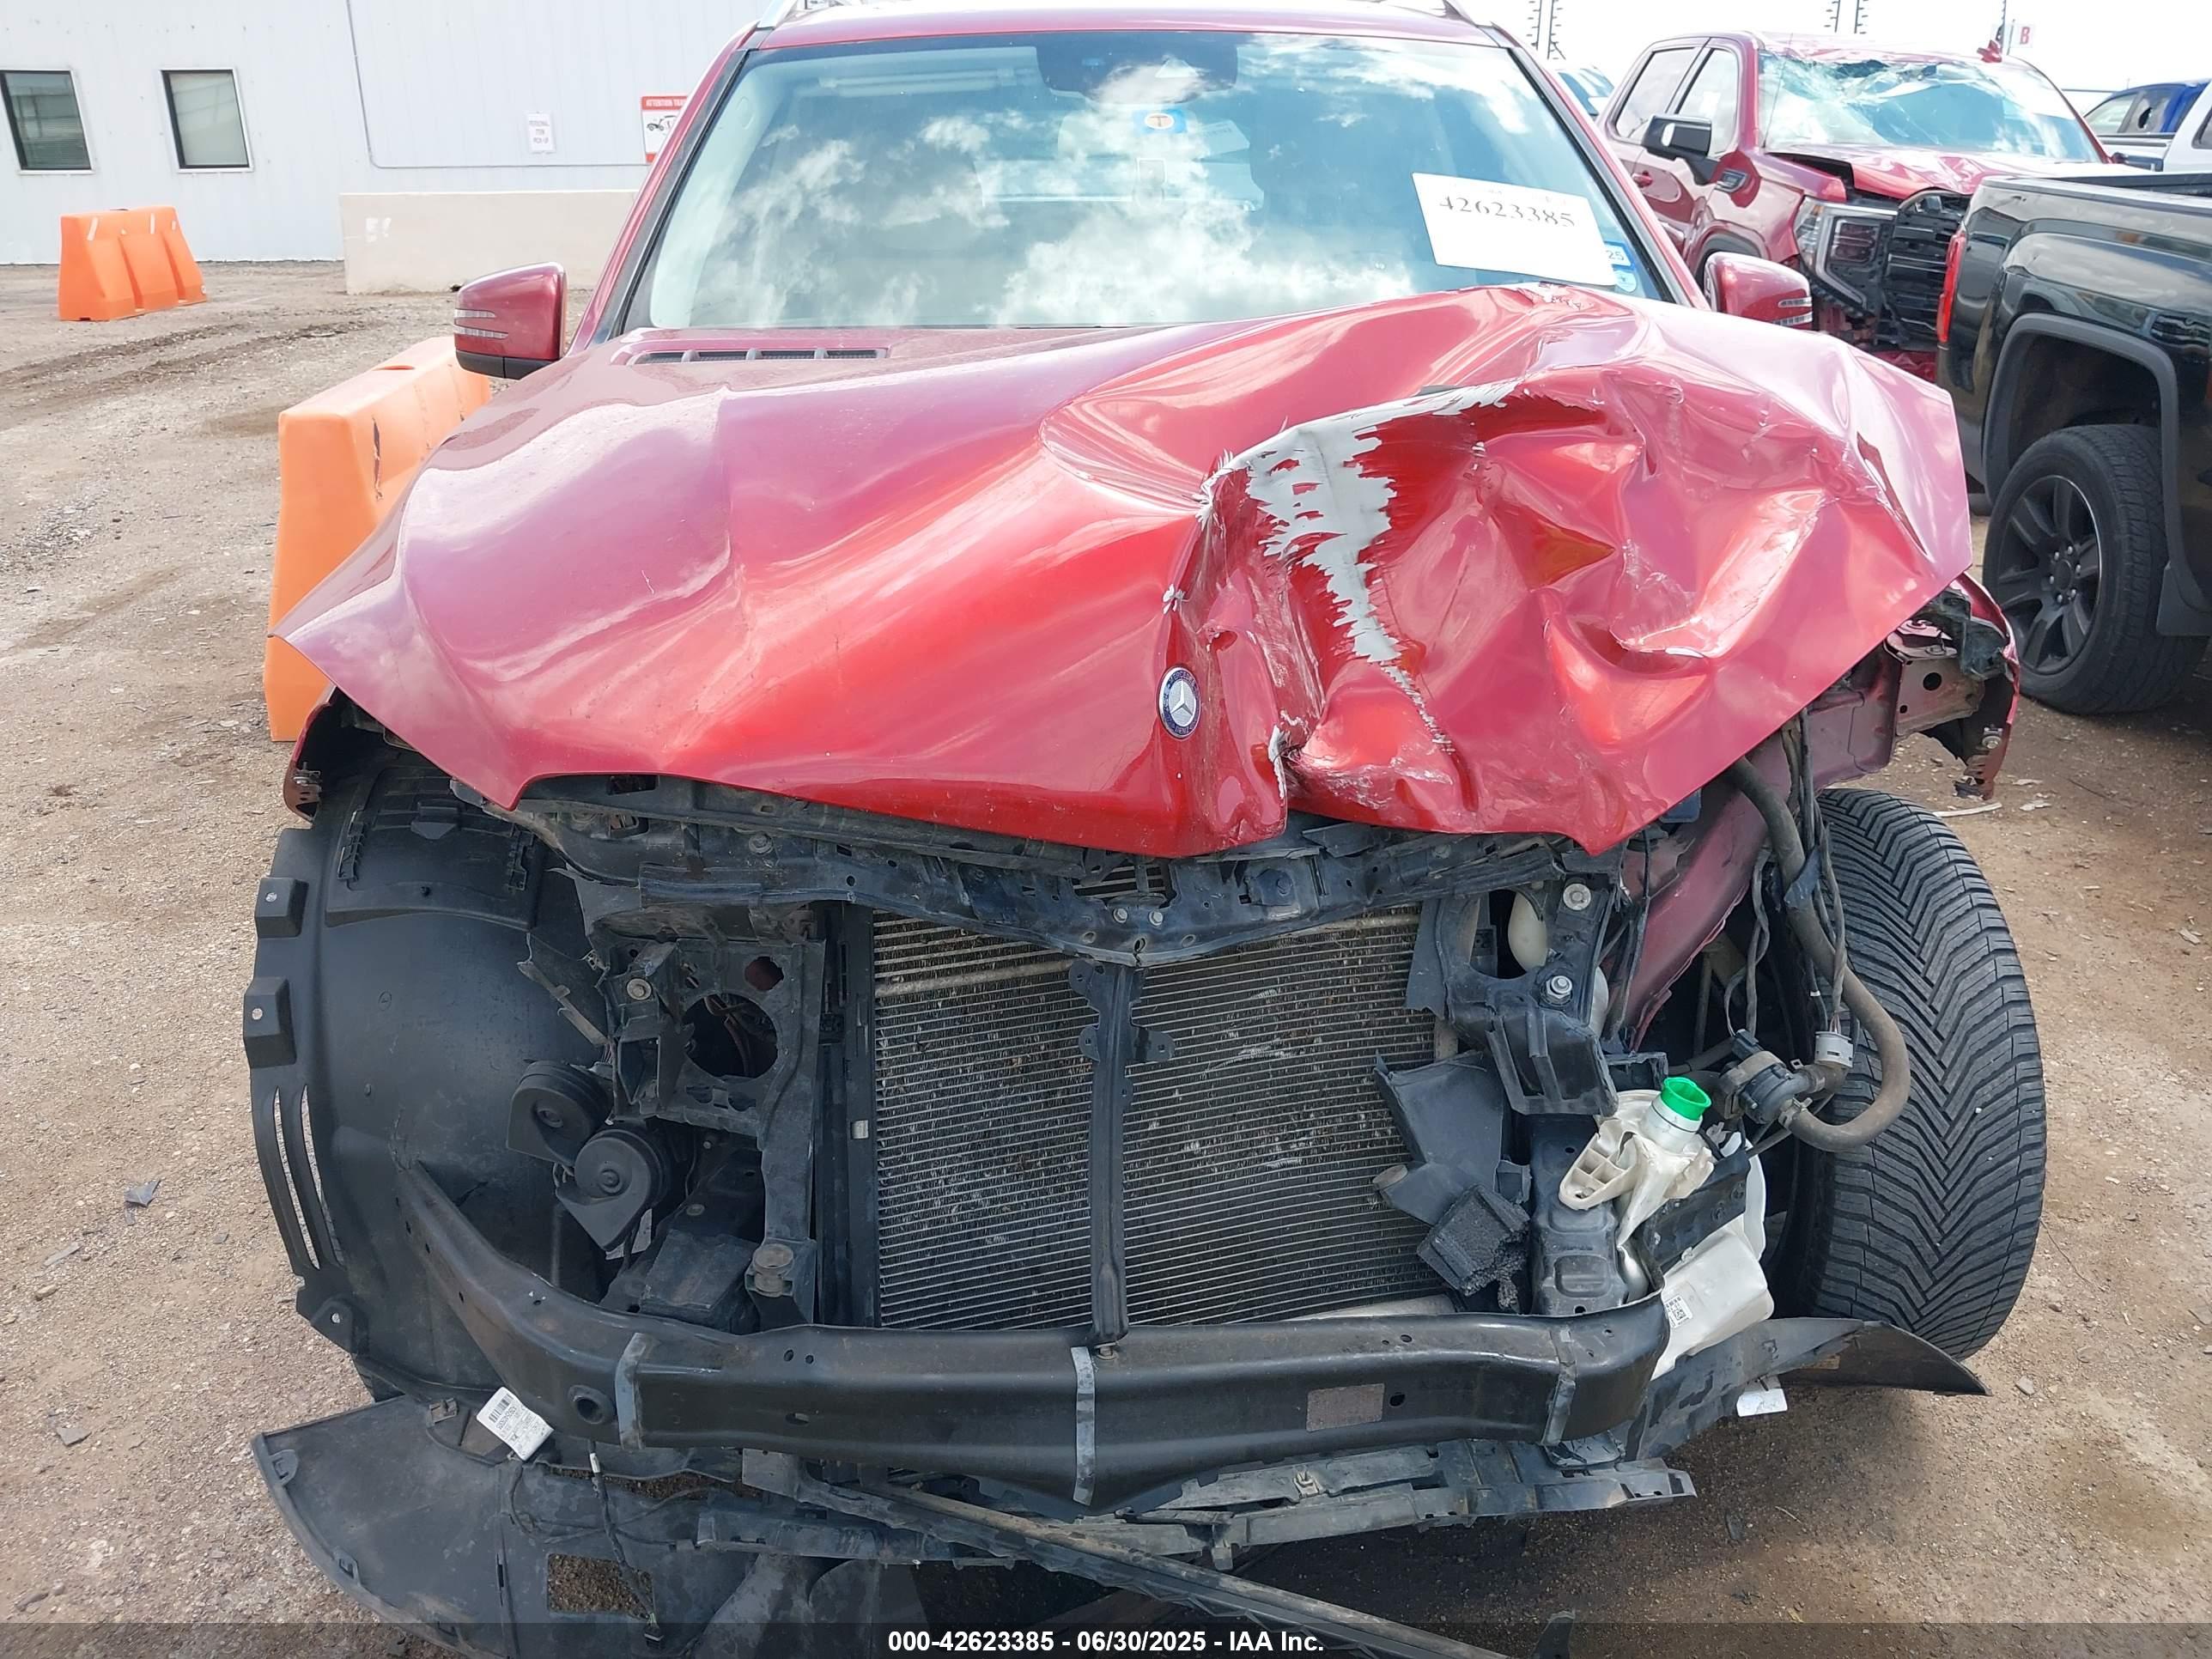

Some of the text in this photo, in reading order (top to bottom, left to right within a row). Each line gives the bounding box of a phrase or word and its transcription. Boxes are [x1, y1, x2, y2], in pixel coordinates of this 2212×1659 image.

[2020, 26, 2031, 45] B
[1438, 195, 1576, 228] 42623385
[1605, 249, 1625, 261] 25
